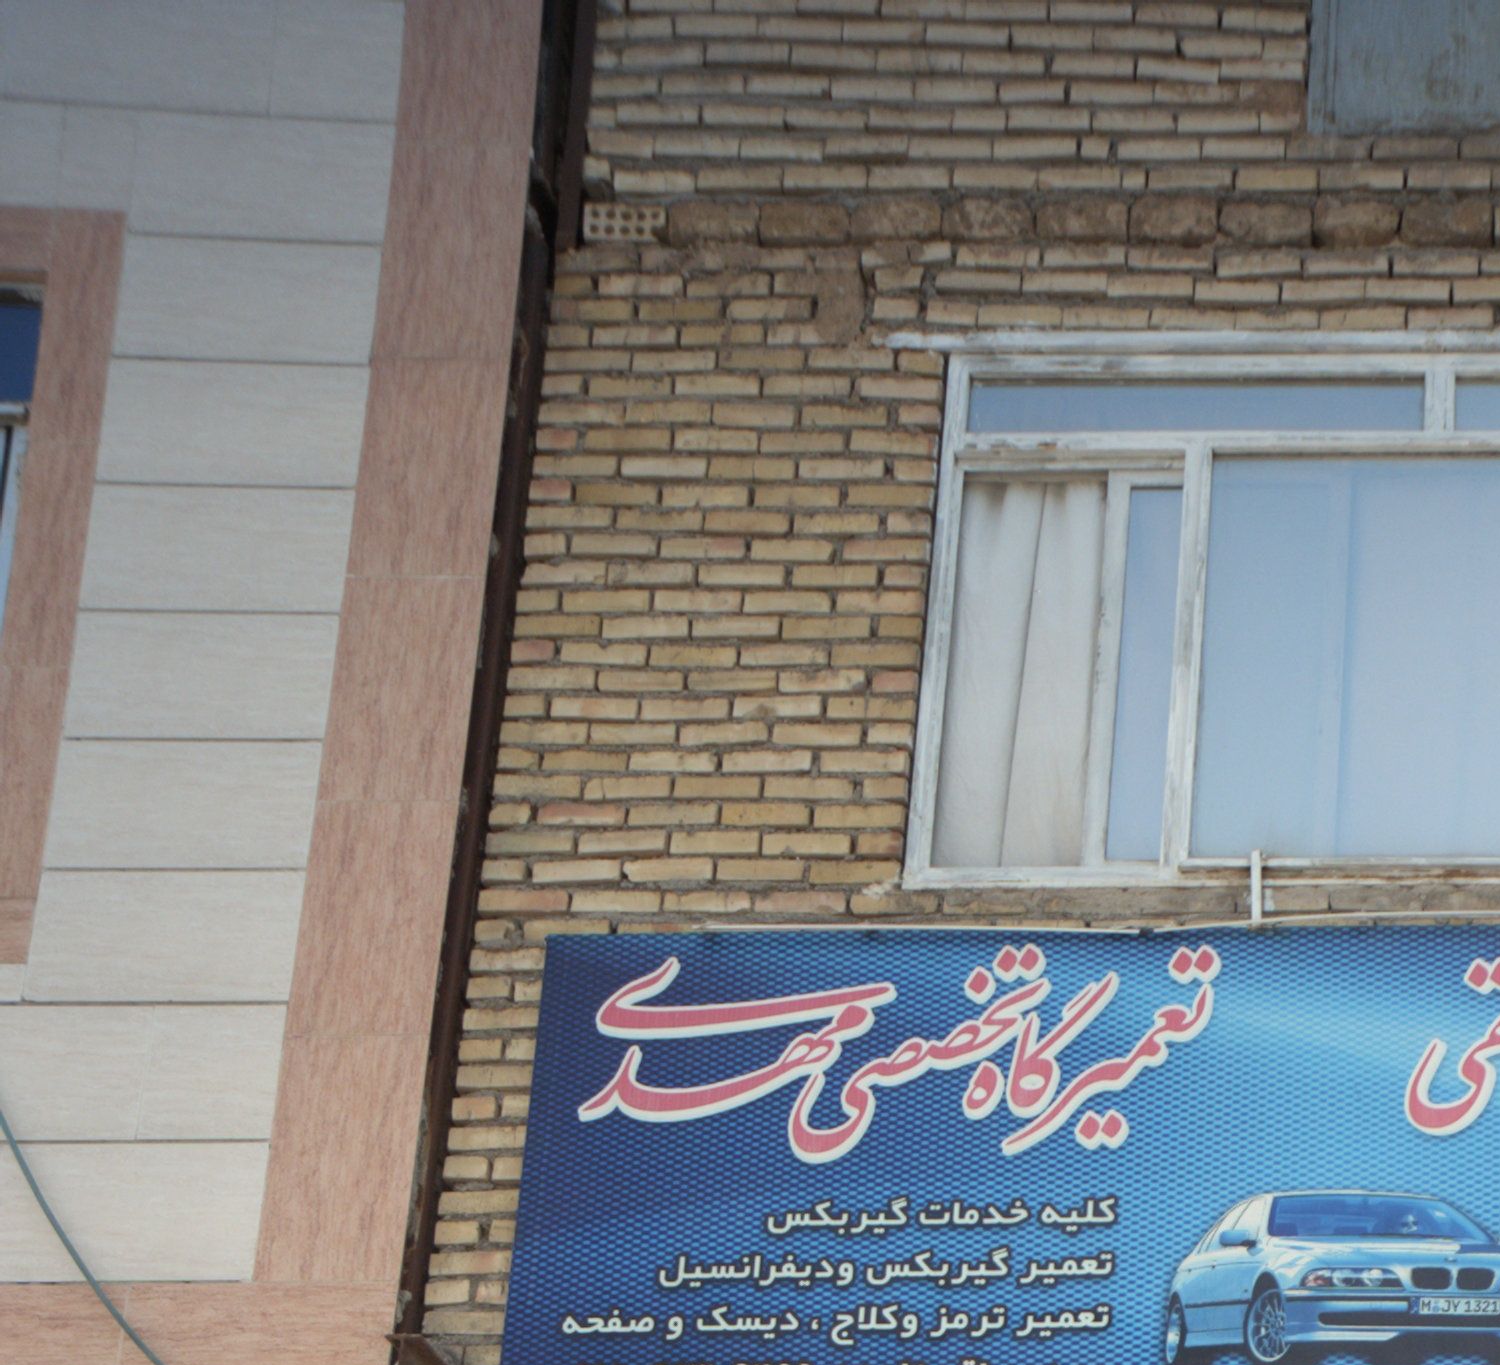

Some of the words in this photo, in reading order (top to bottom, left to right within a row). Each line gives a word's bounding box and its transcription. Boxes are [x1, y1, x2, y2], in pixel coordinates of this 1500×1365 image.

[577, 955, 898, 1124] مهدی
[788, 943, 1053, 1165] تخصصی
[766, 1197, 908, 1235] گیربکس
[918, 1200, 1029, 1225] خدمات
[1040, 1198, 1116, 1232] کلیه
[865, 1247, 1010, 1286] گیربکس
[1019, 1252, 1113, 1285] تعمیر
[561, 1308, 655, 1334] صفحه
[695, 1305, 800, 1340] دیسک
[929, 1306, 1006, 1337] ترمز
[1015, 1305, 1110, 1337] تعمیر
[1421, 1300, 1431, 1313] M
[1463, 1300, 1500, 1313] 1321
[665, 1315, 684, 1340] و
